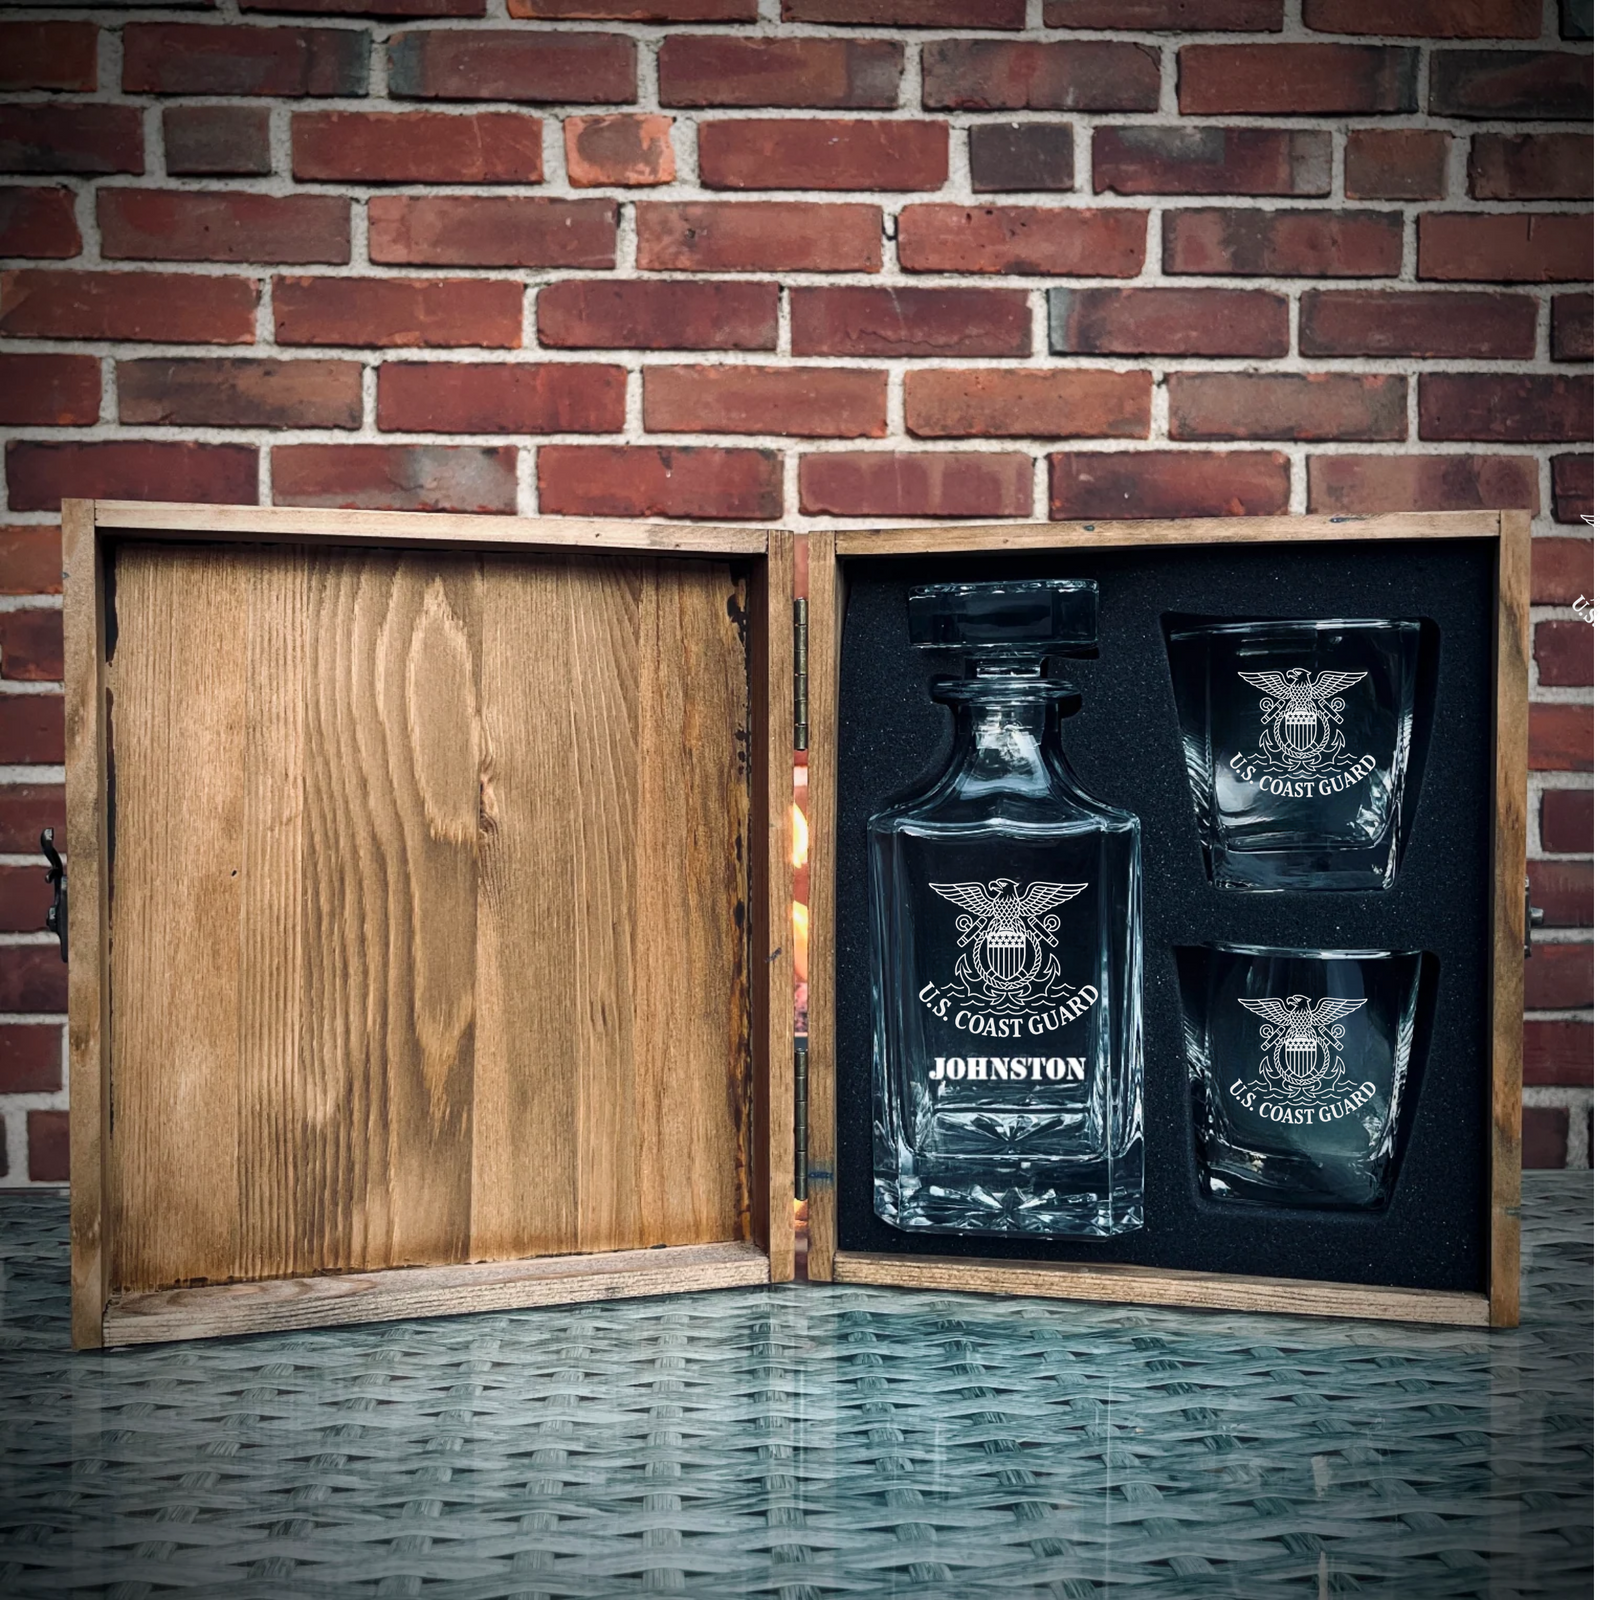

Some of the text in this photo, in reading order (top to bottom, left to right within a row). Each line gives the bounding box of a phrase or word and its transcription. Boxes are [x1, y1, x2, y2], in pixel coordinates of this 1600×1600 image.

[1229, 752, 1377, 798] U.S. COAST GUARD
[918, 981, 1099, 1037] U.S. COAST GUARD
[929, 1057, 1087, 1080] JOHNSTON
[1229, 1078, 1377, 1124] U.S. COAST GUARD
